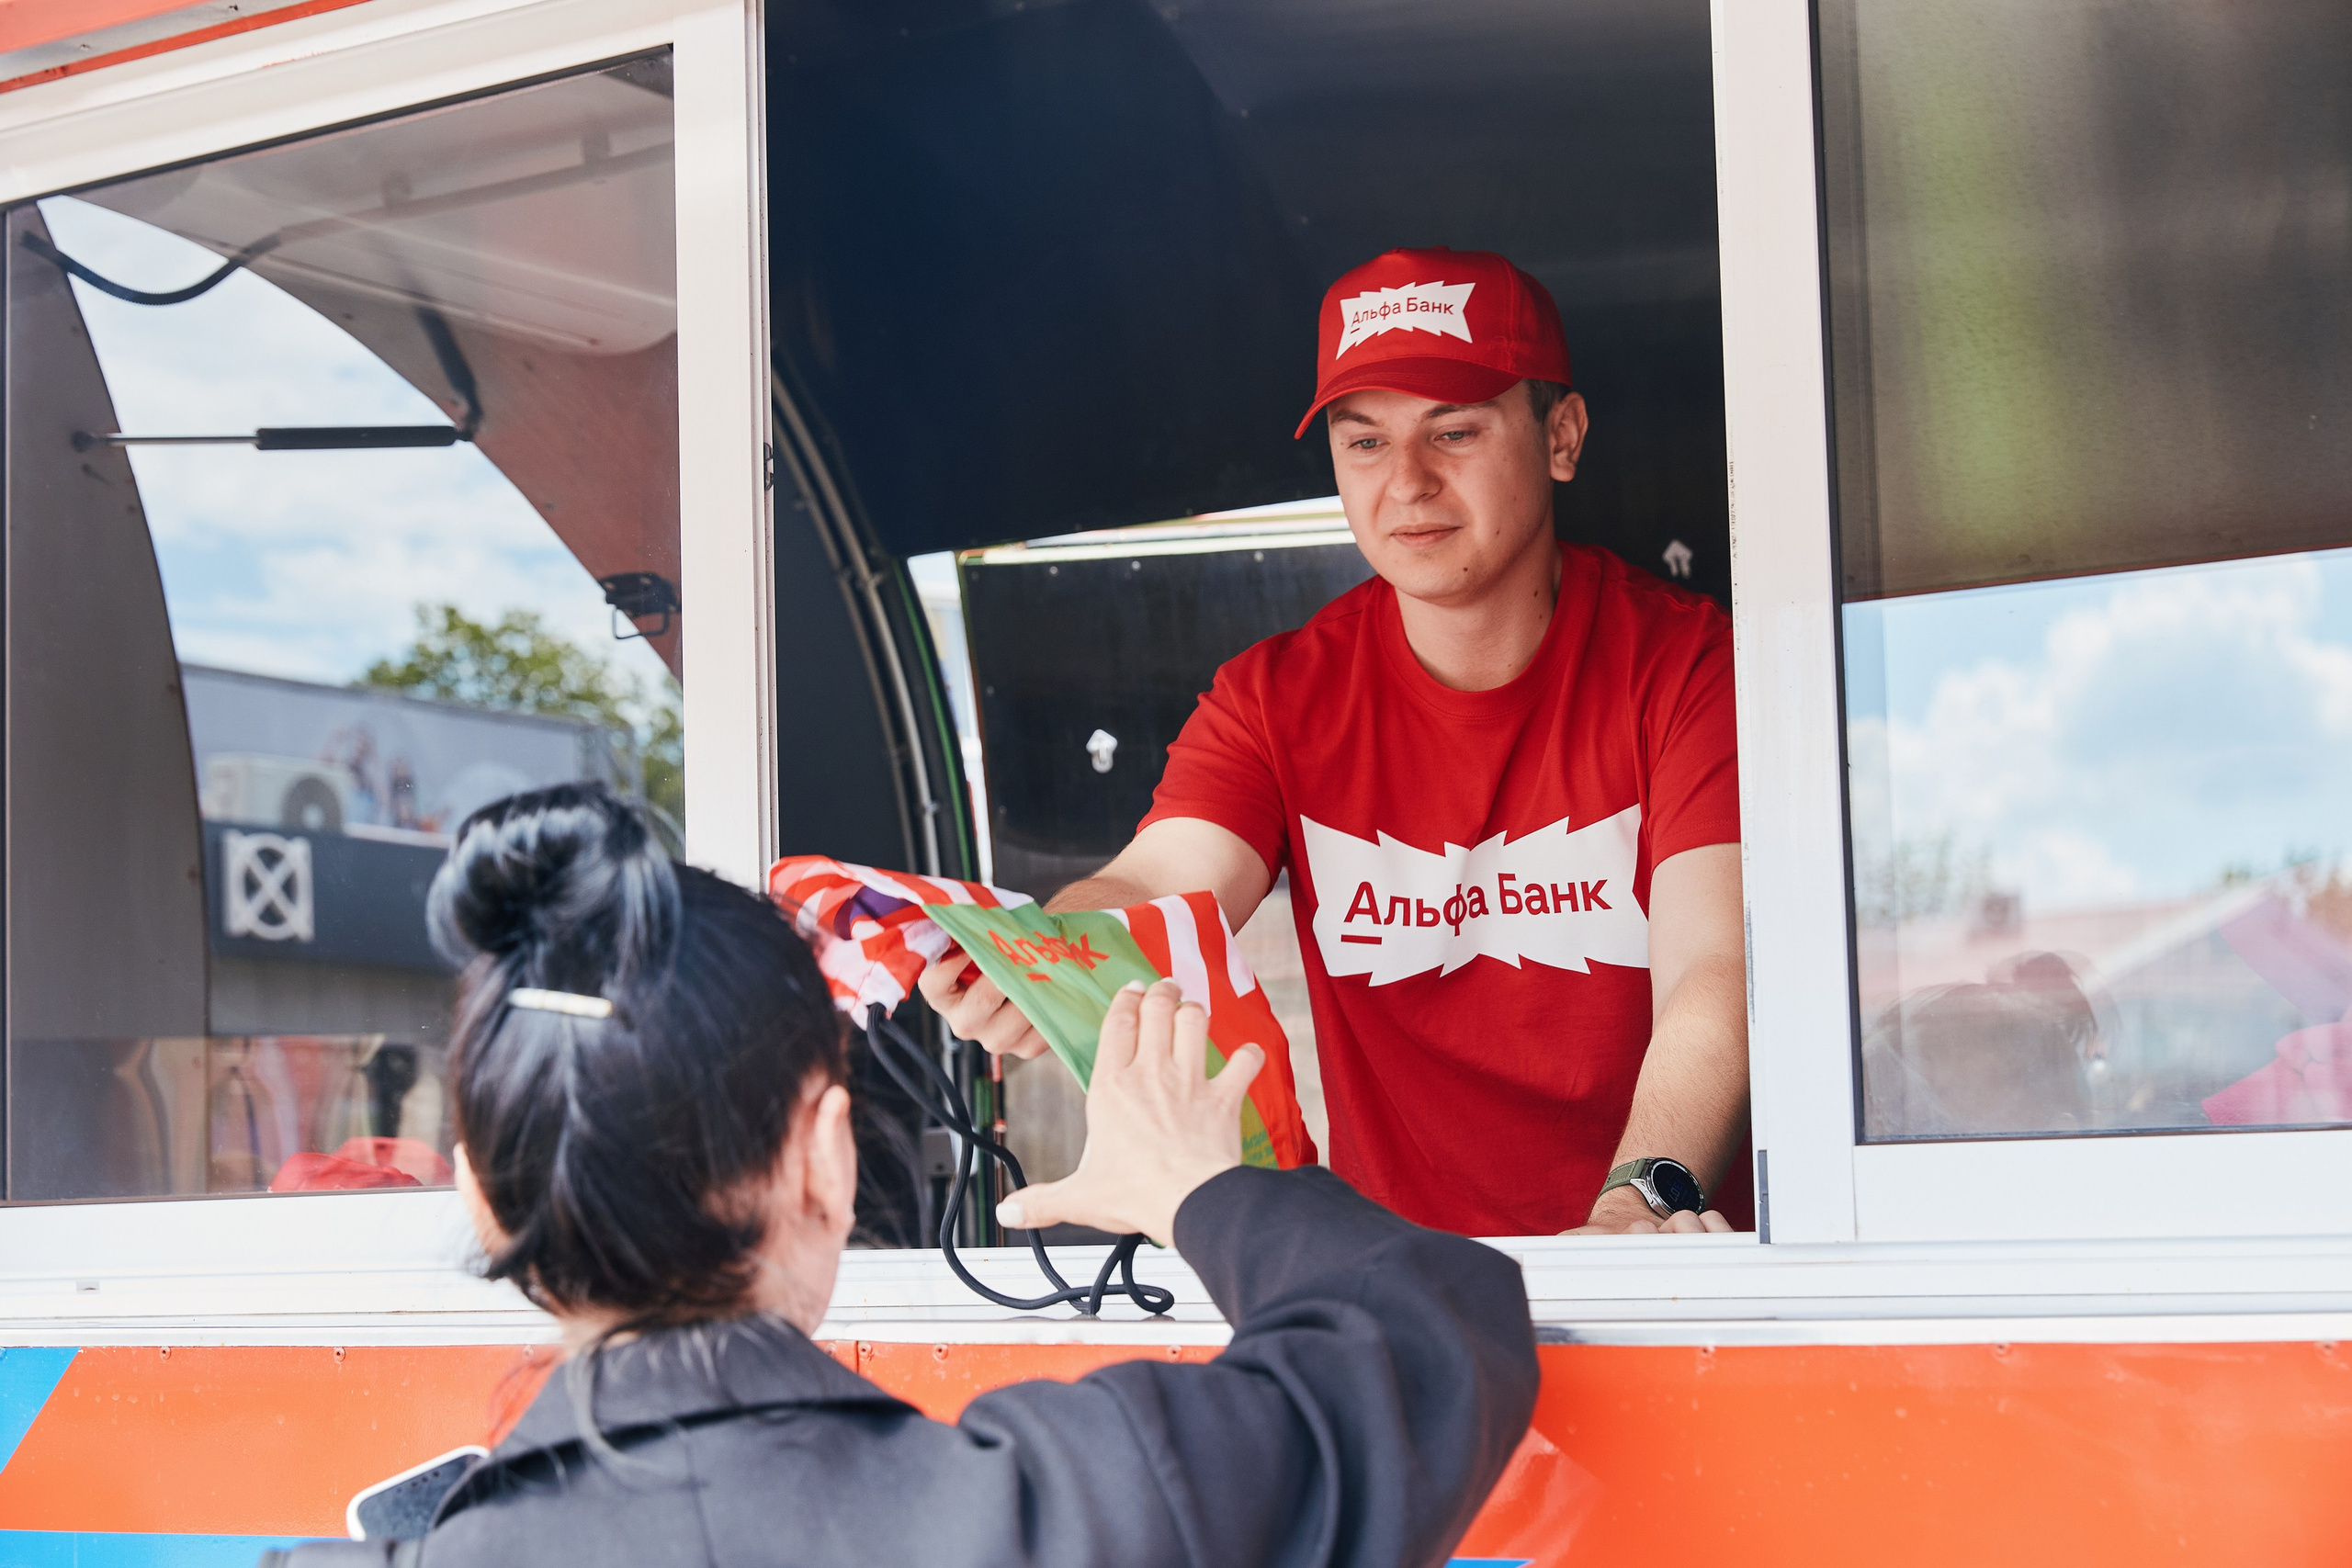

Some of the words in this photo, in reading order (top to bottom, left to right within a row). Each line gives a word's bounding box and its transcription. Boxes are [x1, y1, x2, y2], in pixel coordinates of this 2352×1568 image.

[1351, 301, 1401, 333] Альфа
[1407, 297, 1454, 315] Банк
[1340, 881, 1489, 945] Альфа
[1498, 873, 1613, 915] Банк
